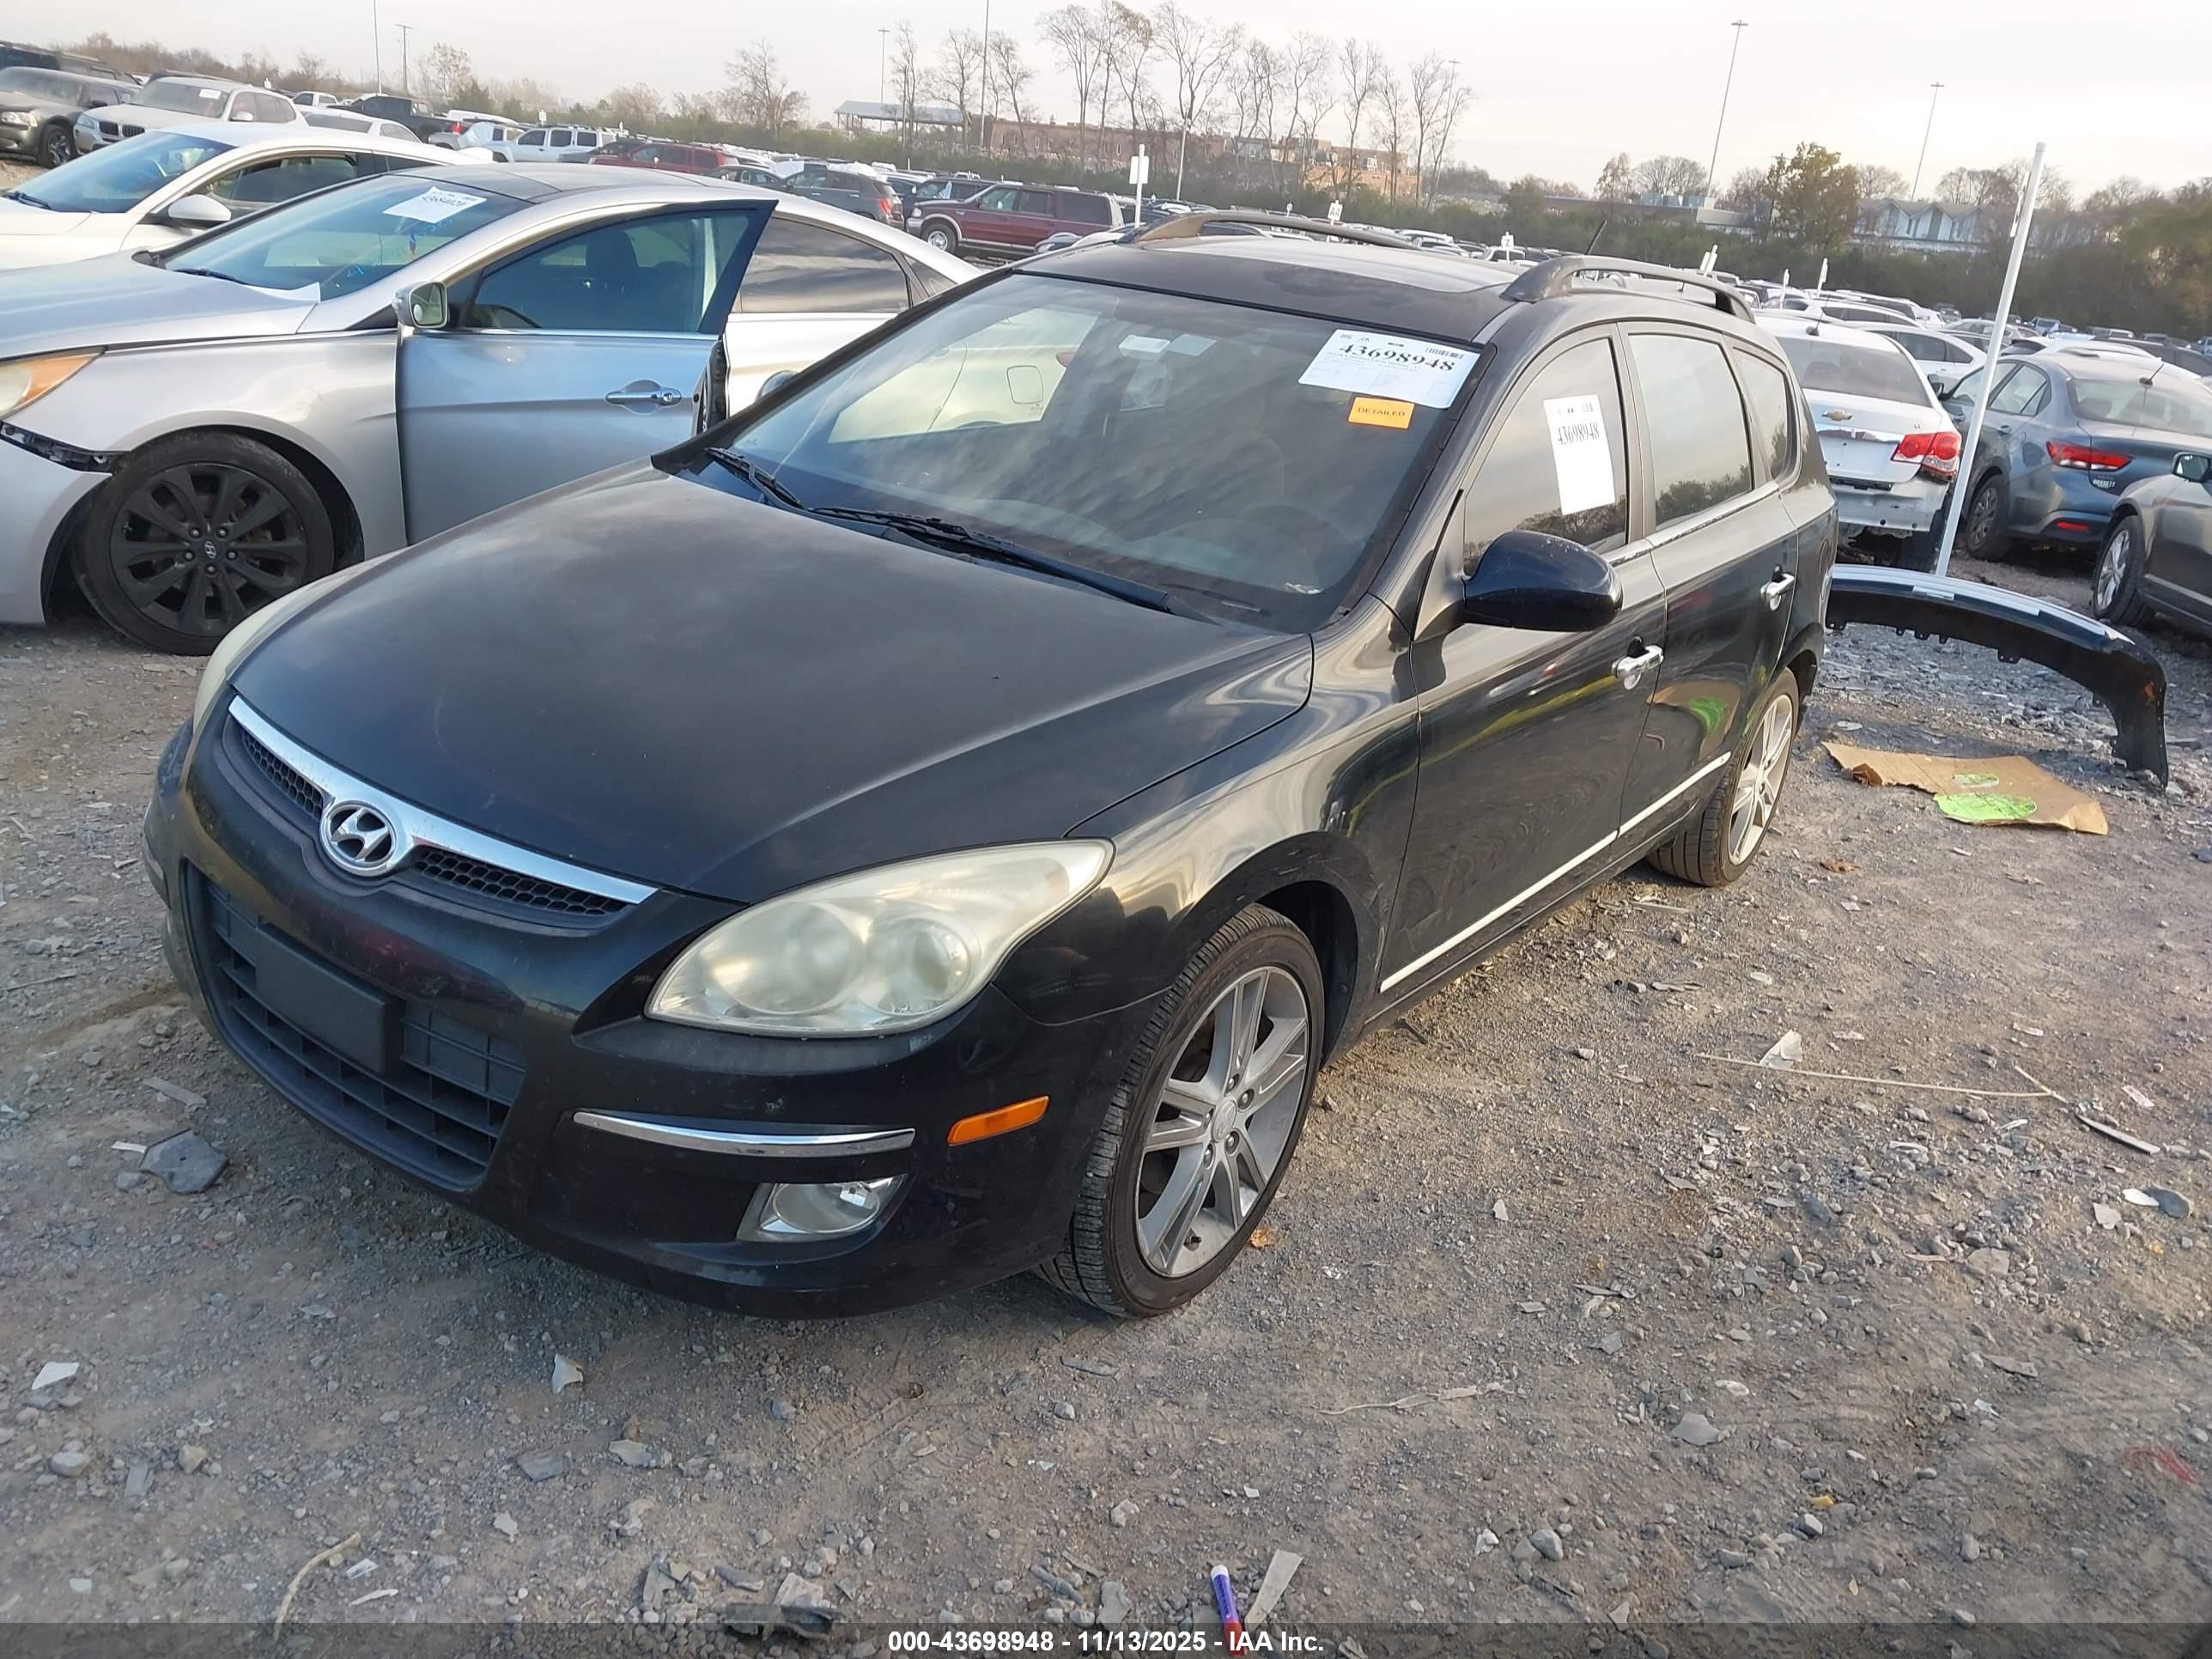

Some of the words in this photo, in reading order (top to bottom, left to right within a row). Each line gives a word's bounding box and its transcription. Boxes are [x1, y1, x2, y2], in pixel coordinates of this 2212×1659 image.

[1339, 343, 1456, 372] 43698948
[1358, 406, 1406, 417] DETAILED
[1557, 421, 1601, 446] 43698948
